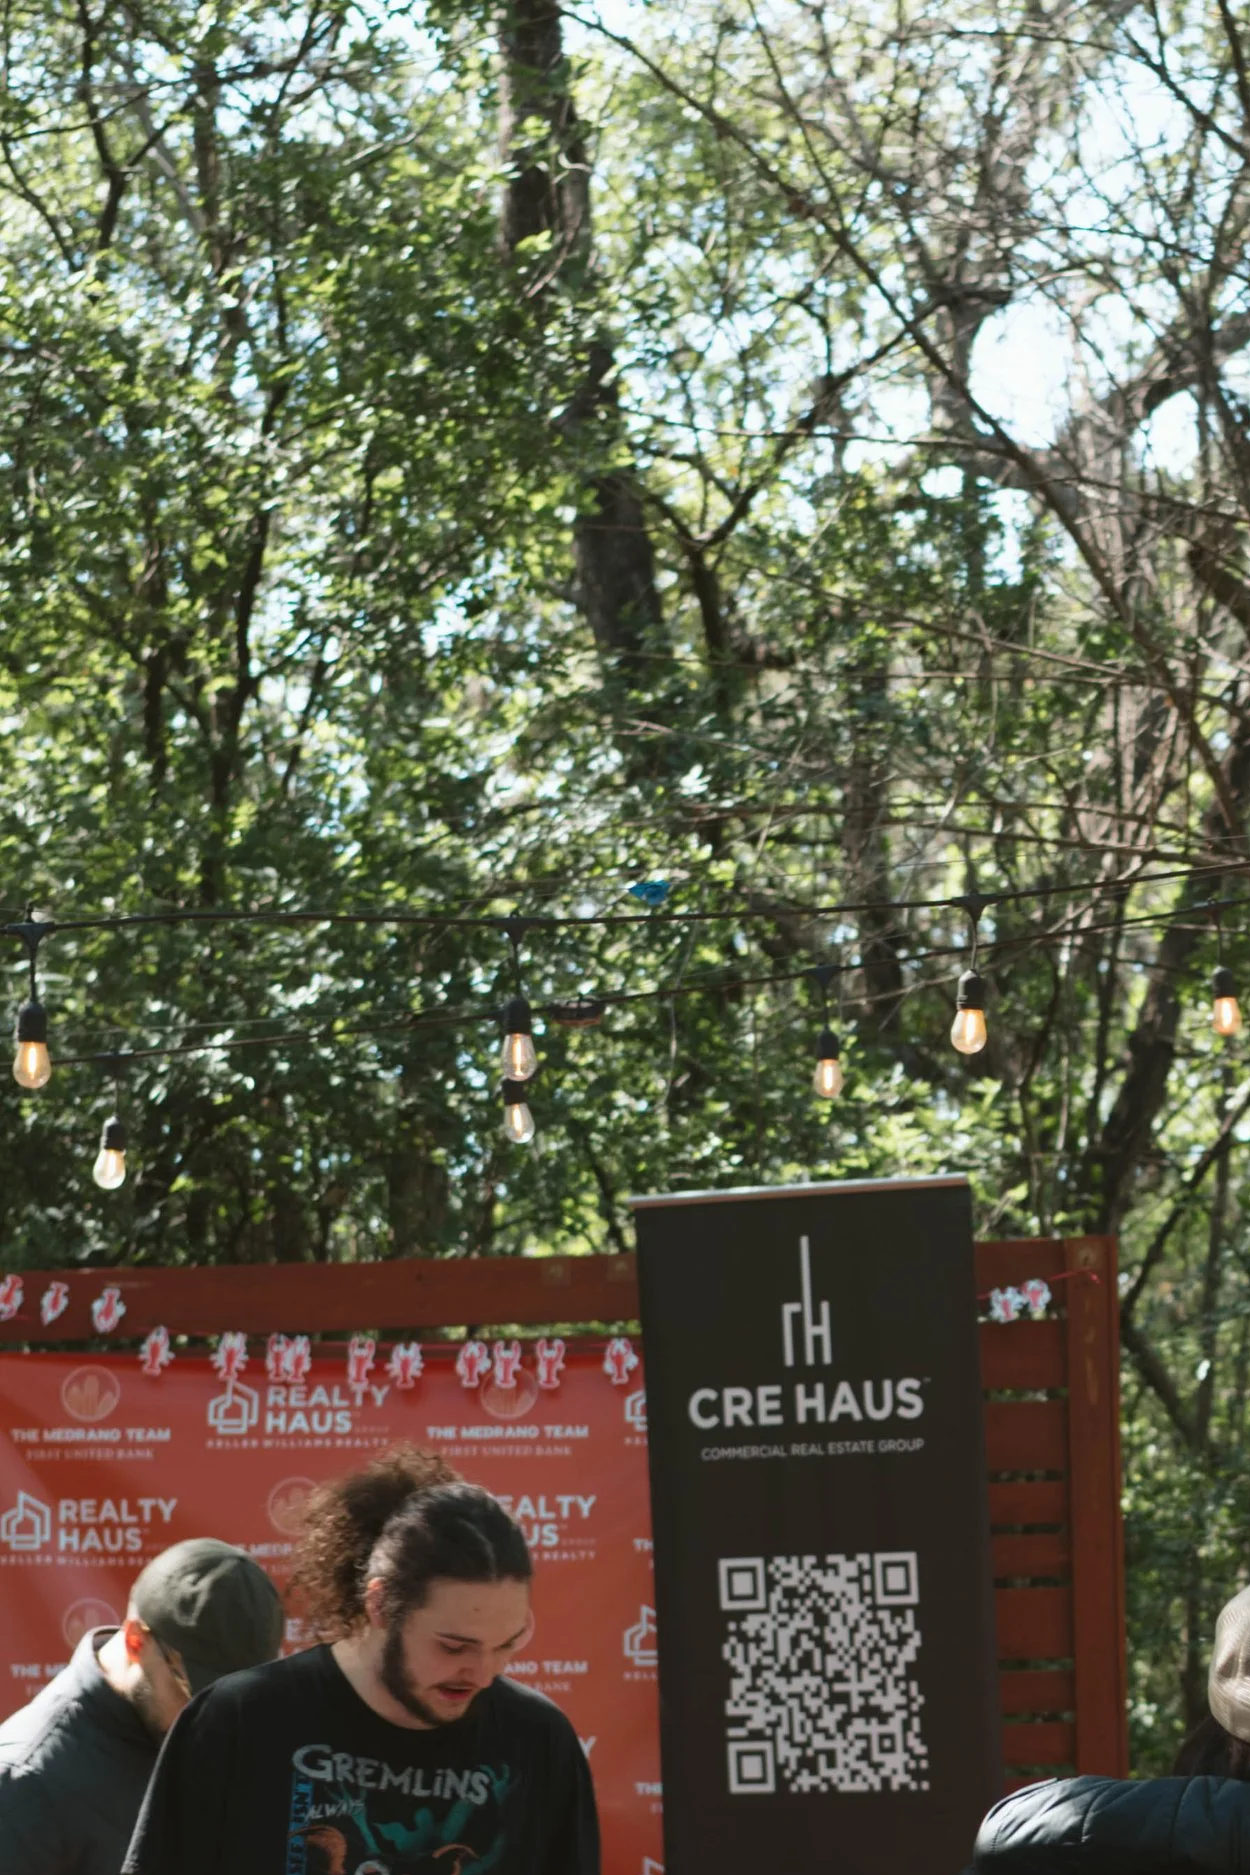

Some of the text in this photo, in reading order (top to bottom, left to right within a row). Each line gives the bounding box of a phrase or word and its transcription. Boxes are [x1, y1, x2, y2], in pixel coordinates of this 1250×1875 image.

[266, 1385, 390, 1407] REALTY
[688, 1377, 925, 1430] CRE HAUS
[265, 1411, 352, 1434] HAUS
[426, 1425, 589, 1440] THE MEDRANO TEAM
[11, 1427, 172, 1442] THE MEDRANO TEAM
[701, 1437, 925, 1462] COMMERCIAL REAL ESTATE GROUP
[58, 1498, 178, 1523] REALTY
[495, 1495, 597, 1519] EALTY
[58, 1527, 143, 1552] HAUS
[10, 1663, 40, 1678] THE
[543, 1660, 588, 1674] TEAM
